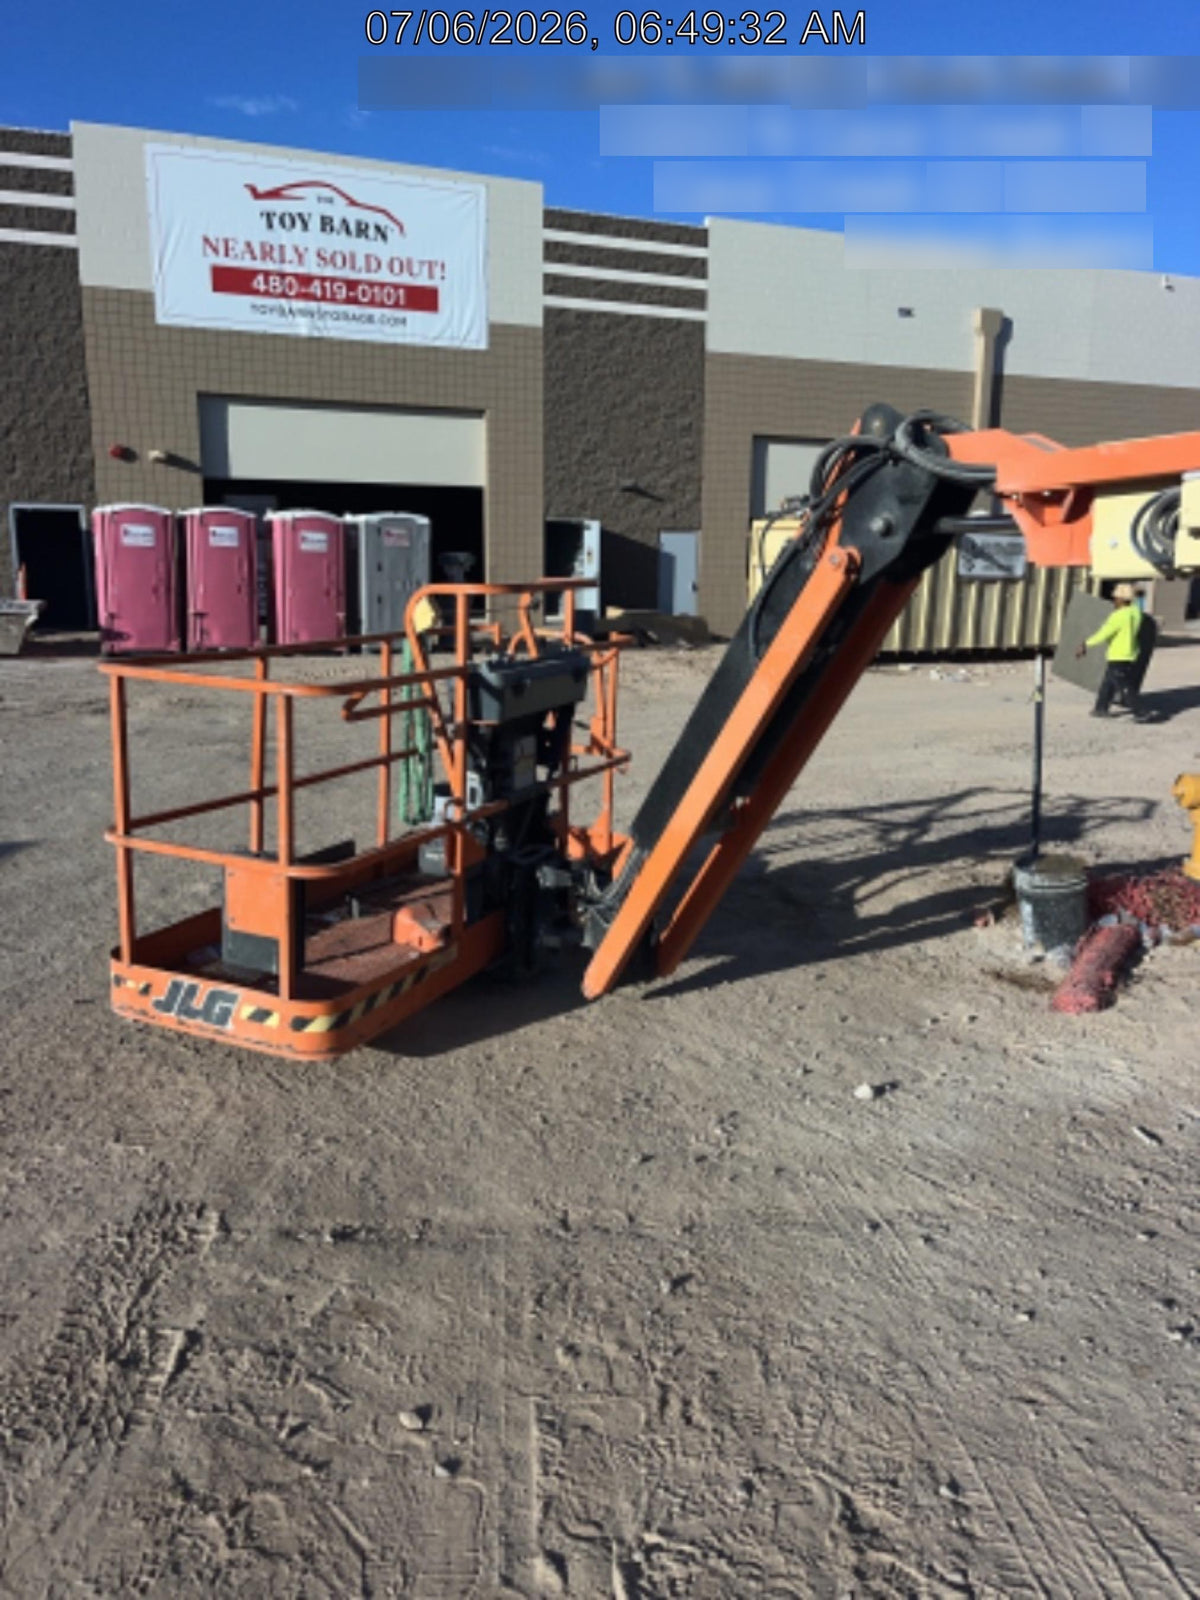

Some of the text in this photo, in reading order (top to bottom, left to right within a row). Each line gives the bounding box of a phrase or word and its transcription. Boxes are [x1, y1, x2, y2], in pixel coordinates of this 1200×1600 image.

[259, 211, 388, 244] TOY BARN
[201, 235, 445, 280] NEARLY SOLD OUT!
[252, 272, 406, 306] 480-419-0101
[152, 979, 239, 1028] JLG
